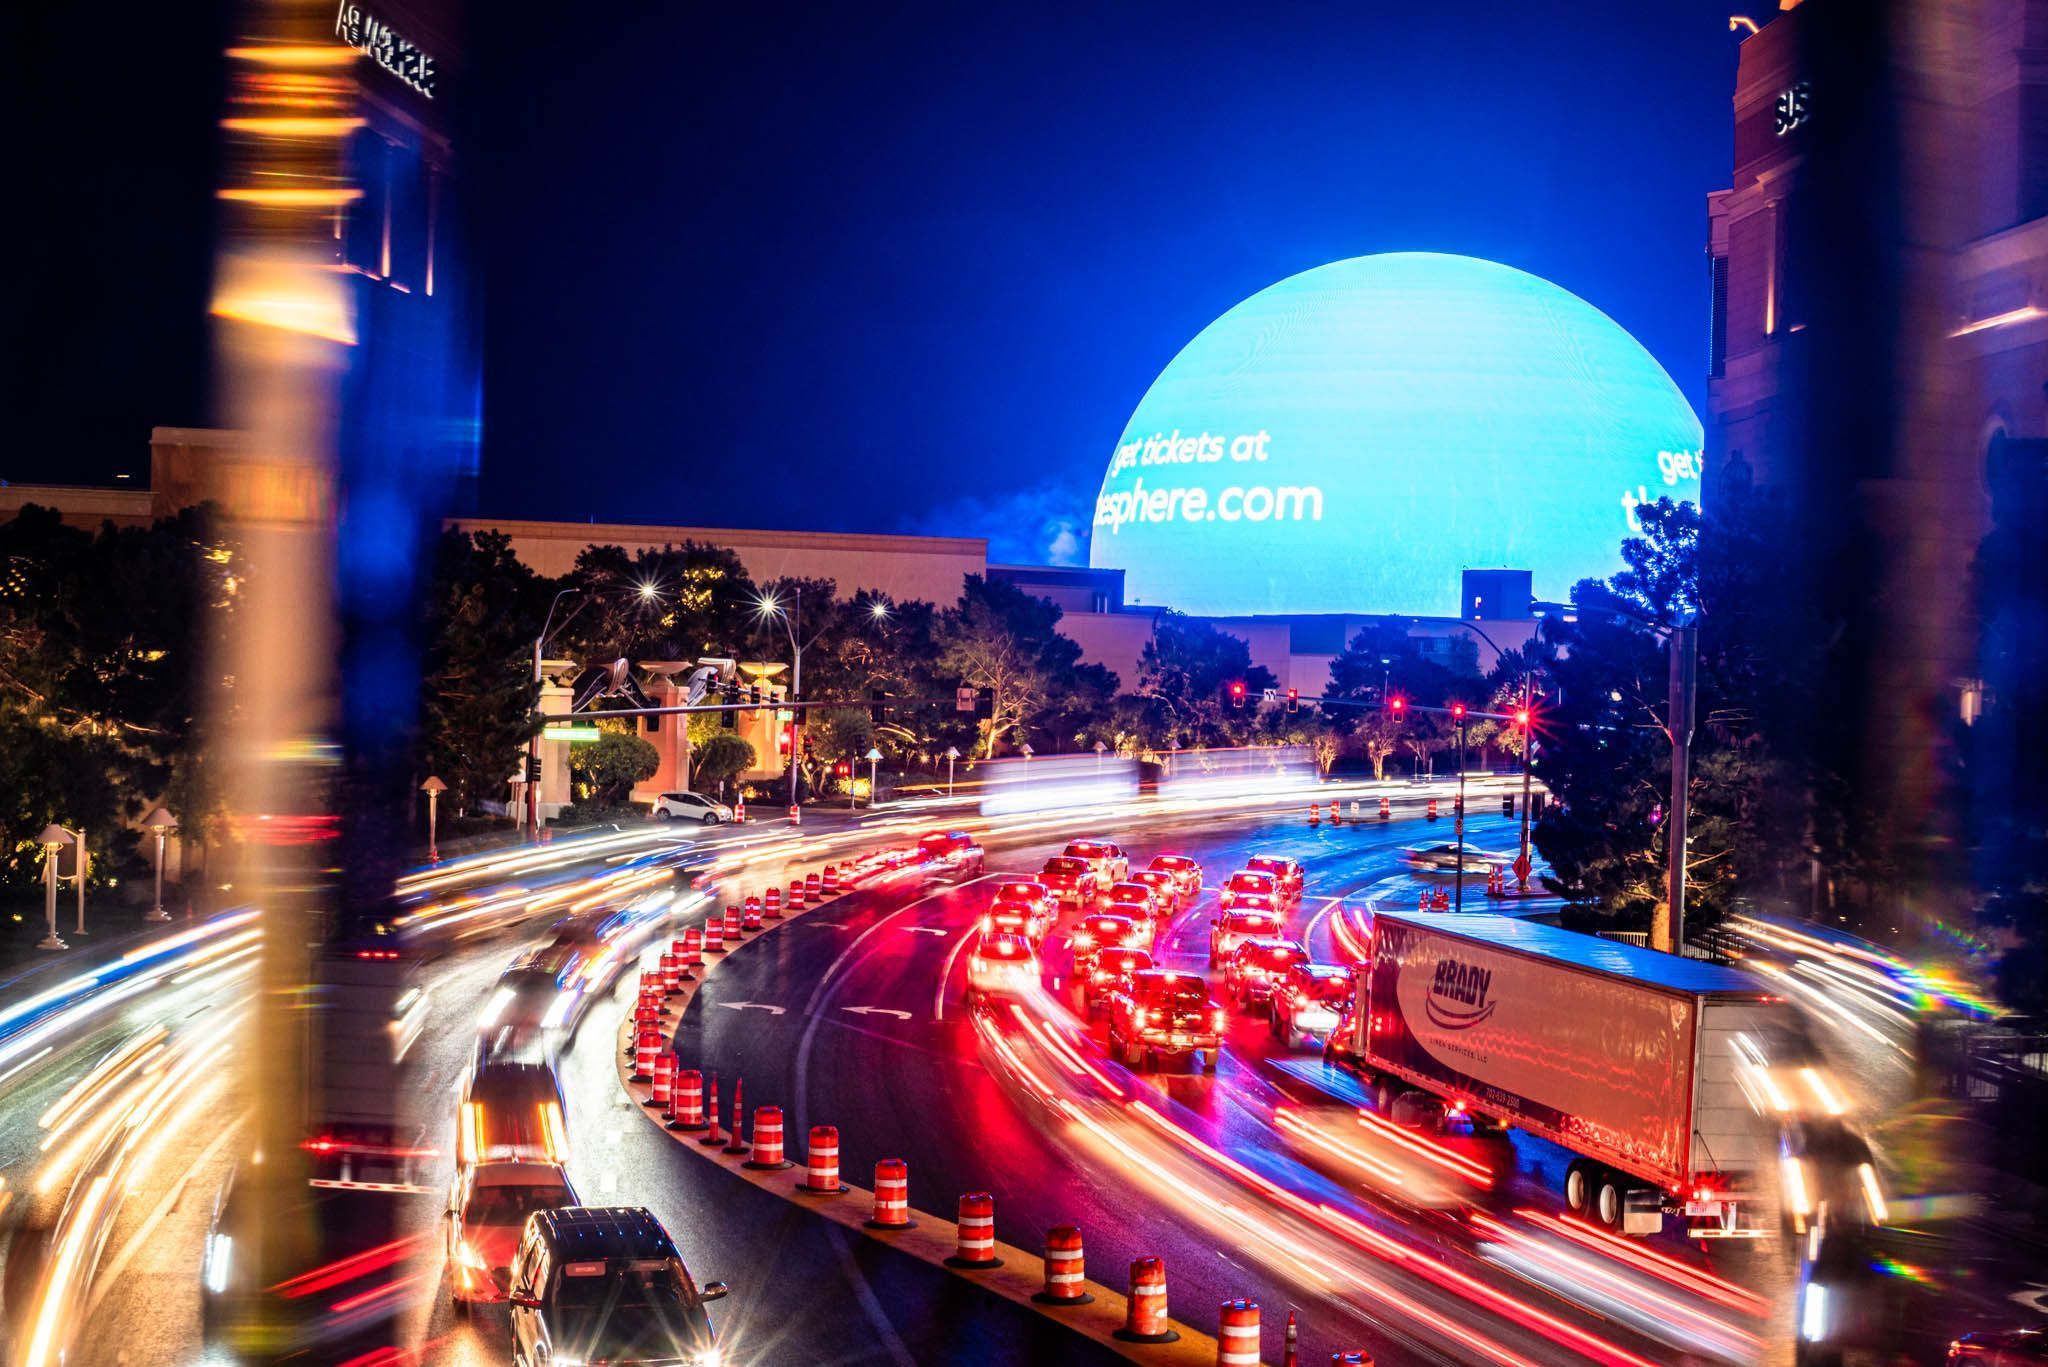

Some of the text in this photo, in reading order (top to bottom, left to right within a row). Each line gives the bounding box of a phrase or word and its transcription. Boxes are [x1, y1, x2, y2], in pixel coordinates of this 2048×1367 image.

[1111, 429, 1271, 478] get tickets at
[1658, 449, 1698, 485] get
[1434, 959, 1491, 1008] BRADY
